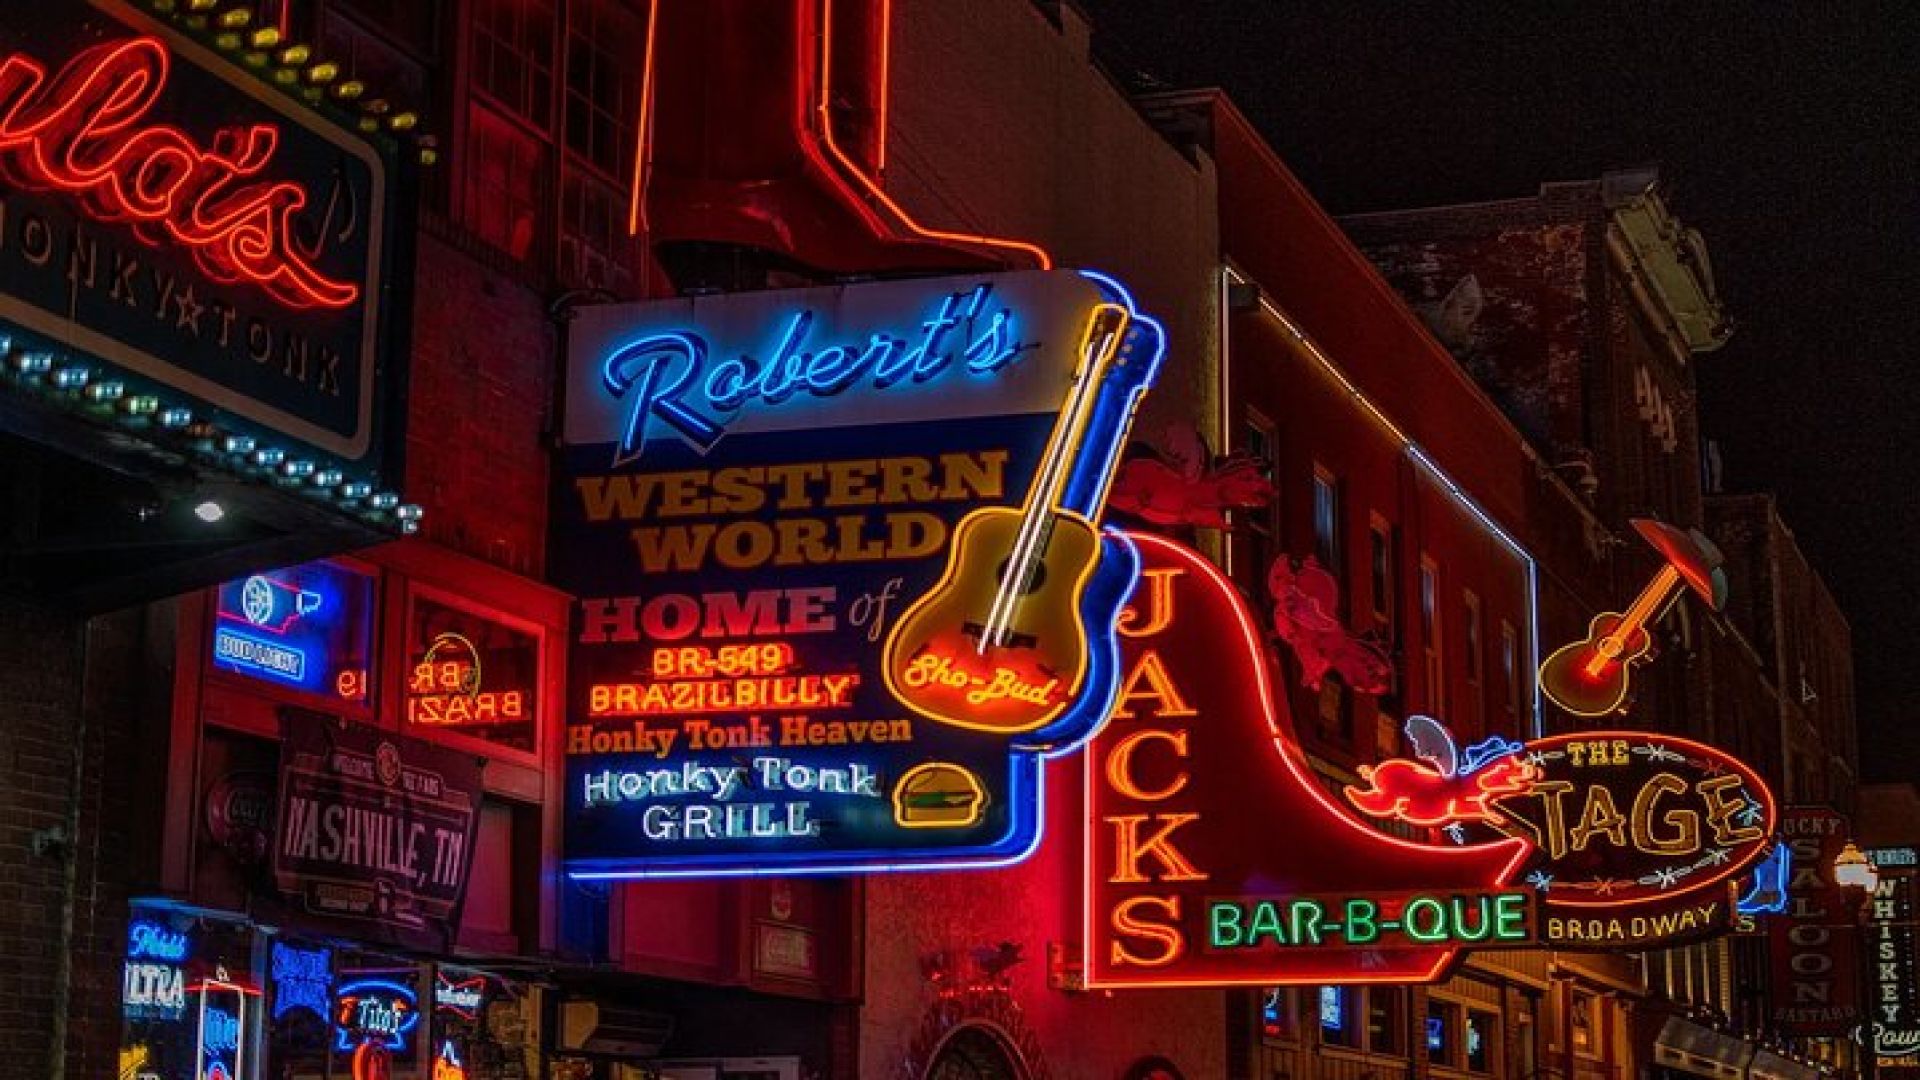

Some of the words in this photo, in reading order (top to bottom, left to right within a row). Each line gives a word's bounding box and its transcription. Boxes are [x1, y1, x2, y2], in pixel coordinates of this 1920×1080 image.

[0, 200, 175, 322] ONKY
[214, 303, 343, 398] TONK
[602, 283, 1038, 468] Robert's
[576, 450, 1010, 522] WESTERN
[631, 511, 947, 574] WORLD
[580, 586, 837, 642] HOME
[849, 577, 903, 641] of
[653, 642, 793, 679] BR-549
[904, 653, 1059, 706] Sho-Bud
[589, 674, 858, 716] BRAZILBILLY
[568, 720, 680, 759] Honky
[684, 717, 771, 749] Tonk
[780, 716, 913, 746] Heaven
[1567, 740, 1630, 766] THE
[584, 760, 742, 803] Honky
[752, 756, 880, 797] Tonk
[1103, 567, 1210, 967] JACKS
[283, 796, 428, 888] NASHVILLE,
[430, 827, 464, 887] TN
[643, 801, 820, 840] GRILL
[1210, 893, 1528, 947] BAR-B-QUE
[1548, 902, 1718, 940] BROADWAY
[1789, 838, 1833, 1006] SALOON
[1873, 879, 1902, 1023] WHISKEY
